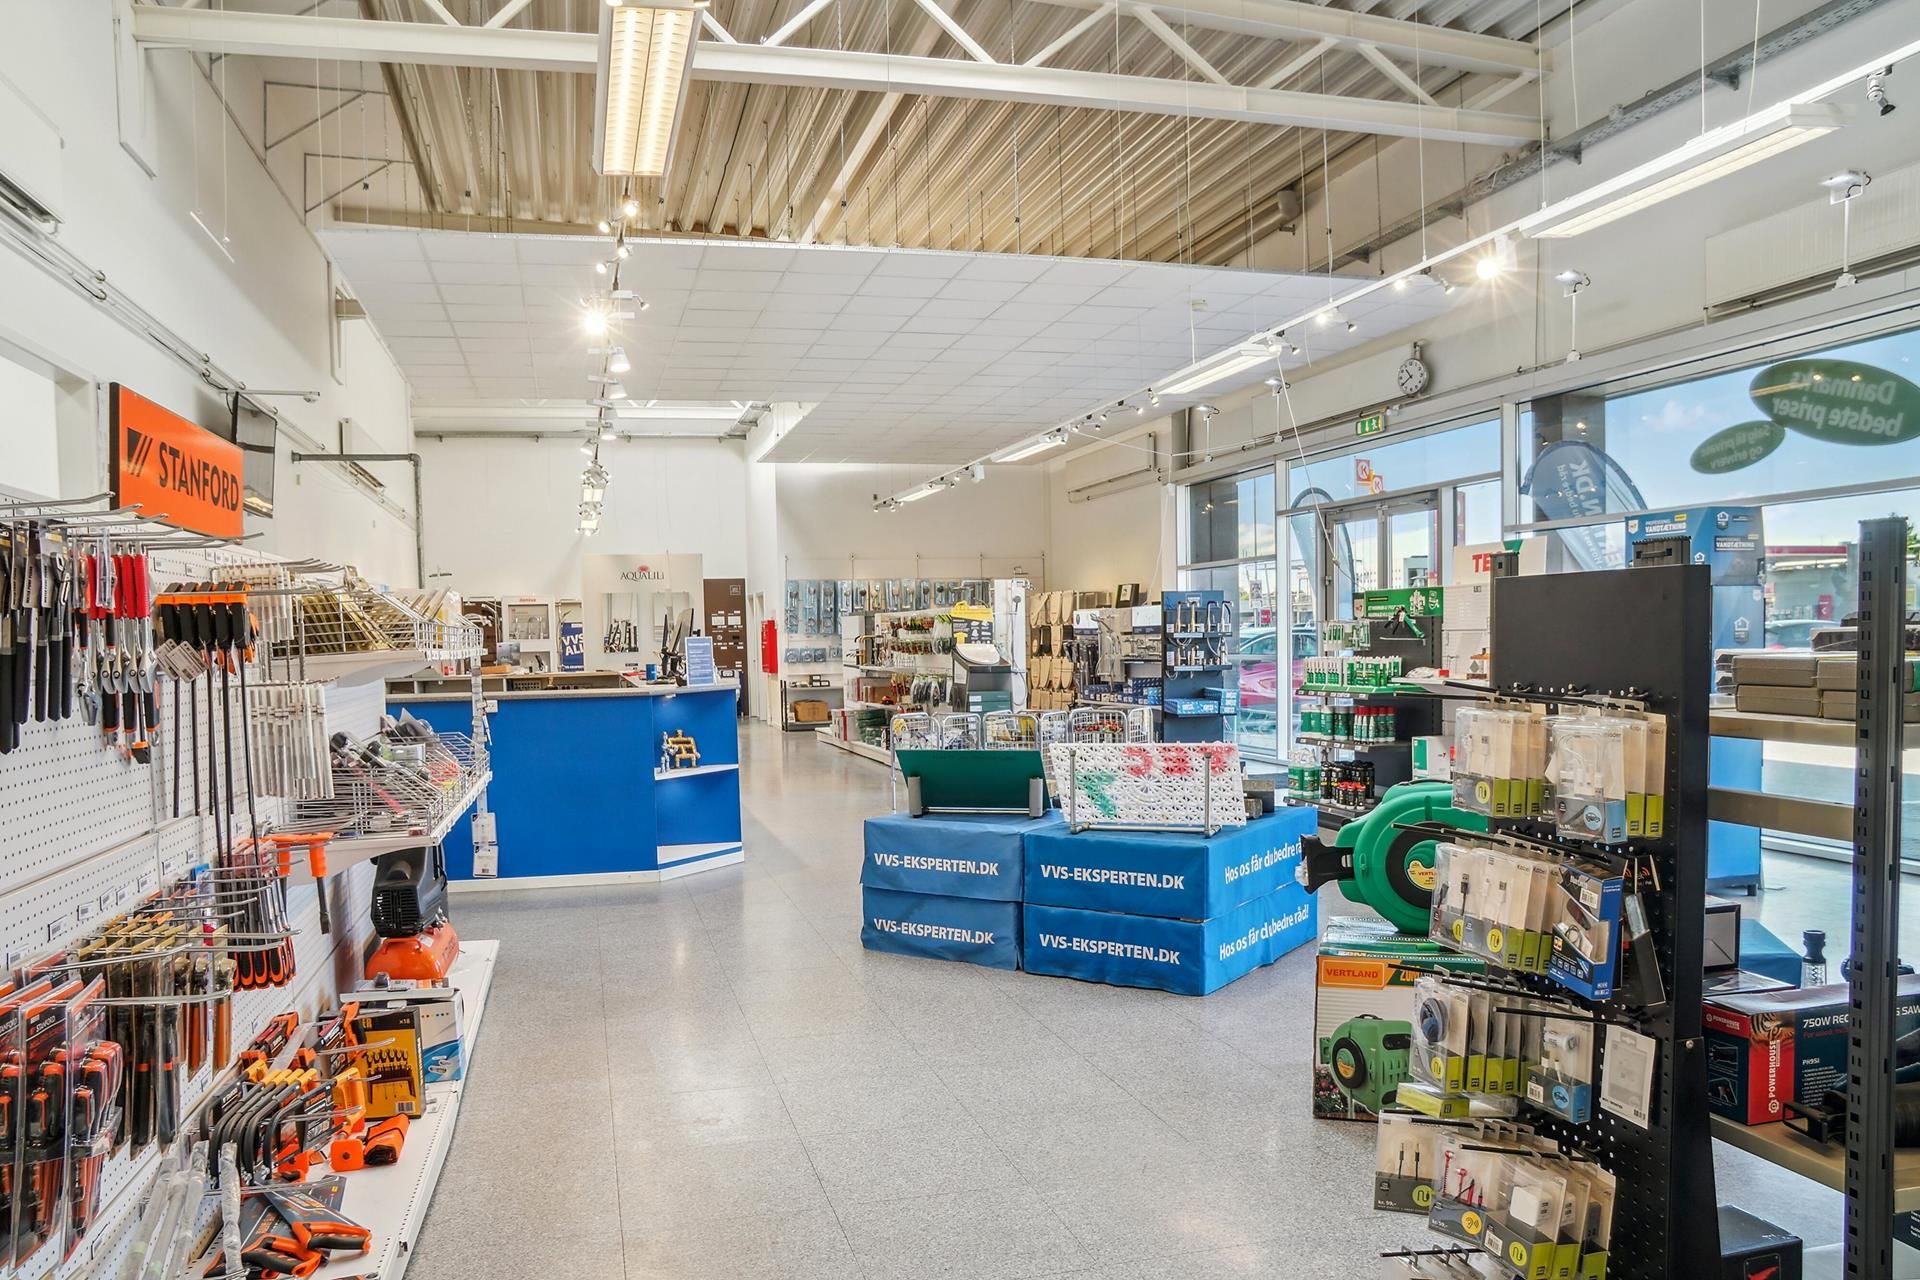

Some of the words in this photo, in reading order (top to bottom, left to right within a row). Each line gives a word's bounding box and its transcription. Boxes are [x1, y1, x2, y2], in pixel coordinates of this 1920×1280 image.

[159, 441, 239, 511] STANFORD
[874, 853, 999, 876] VVS-EKSPERTEN.DK
[1040, 865, 1184, 890] VVS-EKSPERTEN.DK
[1225, 866, 1239, 884] Hos
[1239, 862, 1250, 876] os
[1251, 854, 1262, 872] får
[1273, 842, 1295, 863] bedre
[874, 918, 995, 945] VVS-EKSPERTEN.DK
[1219, 943, 1235, 960] Hos
[1236, 938, 1247, 952] os
[1248, 927, 1259, 945] får
[1271, 913, 1293, 933] bedre
[1294, 903, 1309, 924] råd!
[1039, 933, 1180, 965] VVS-EKSPERTEN.DK
[1325, 967, 1378, 979] VERTLAND
[1803, 1016, 1831, 1028] 750W
[1832, 1013, 1849, 1025] REC
[1768, 1040, 1776, 1098] POWERHOUSE
